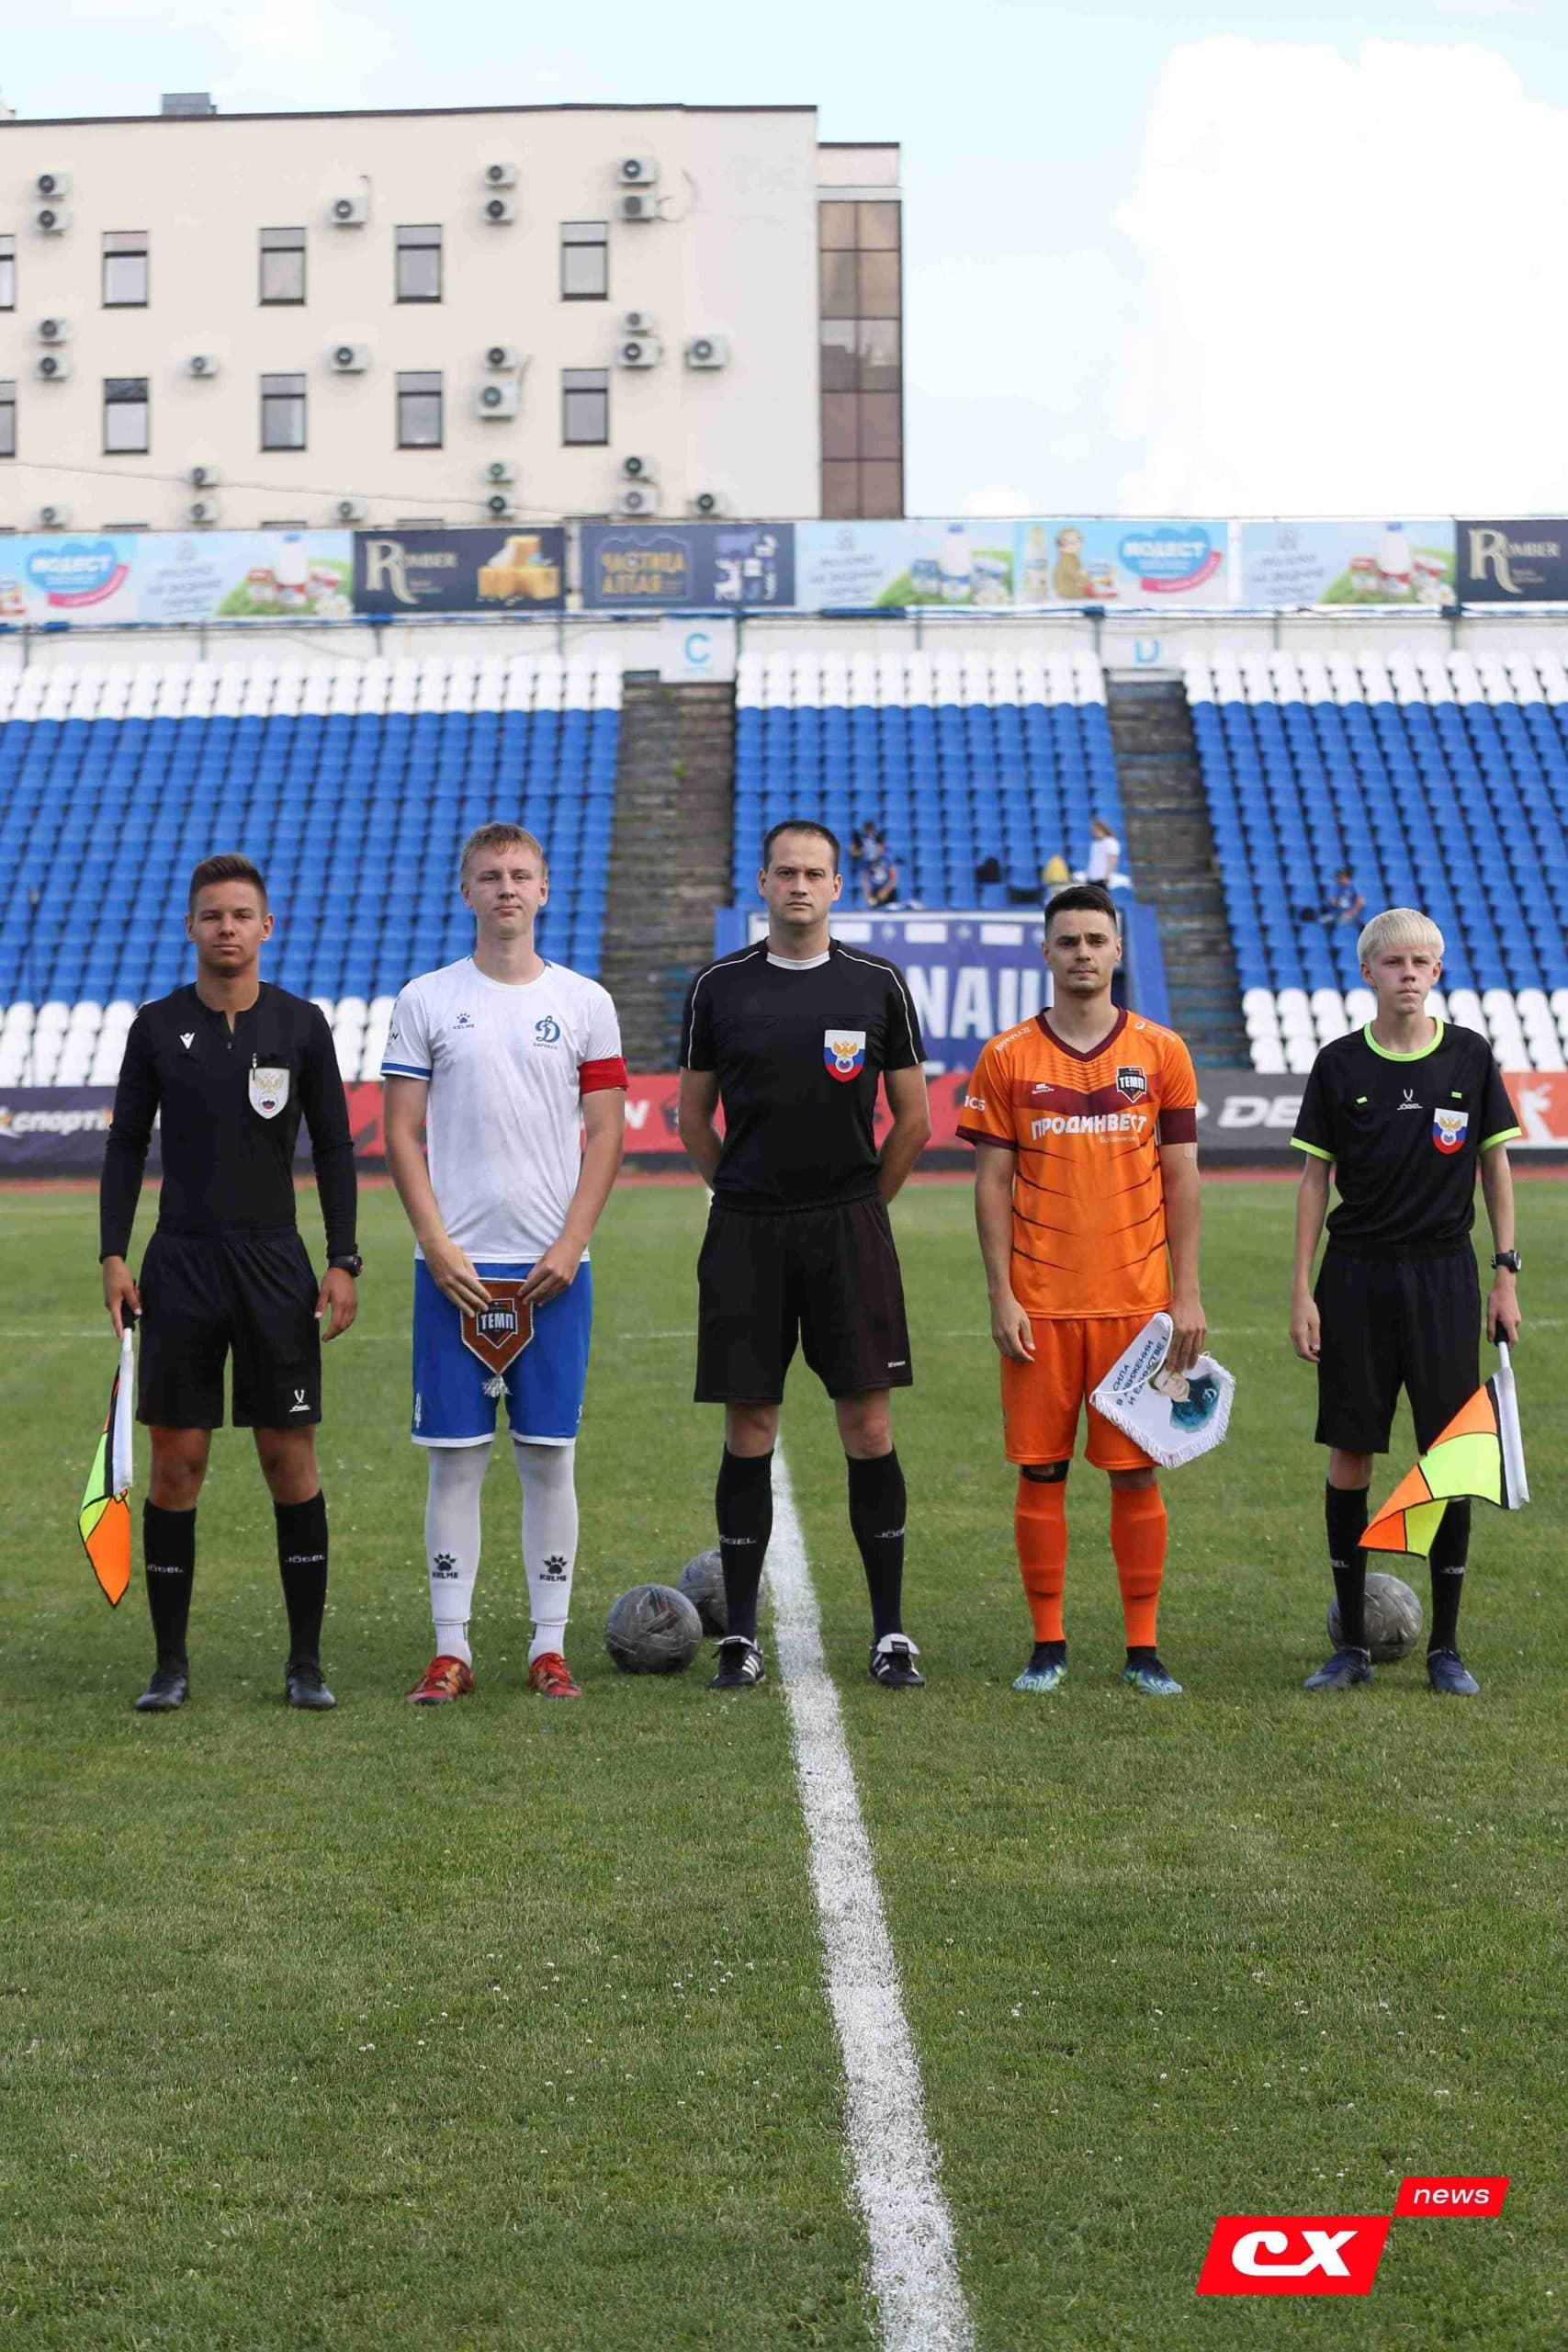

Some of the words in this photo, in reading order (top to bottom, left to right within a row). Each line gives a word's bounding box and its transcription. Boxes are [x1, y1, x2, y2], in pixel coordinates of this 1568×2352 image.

[1119, 1076, 1145, 1091] ТЕМП
[1031, 1113, 1147, 1140] ПРОДИНВЕСТ
[480, 1312, 513, 1329] ТЕМП
[1112, 1364, 1130, 1391] СИЛА
[432, 1571, 458, 1579] KELME
